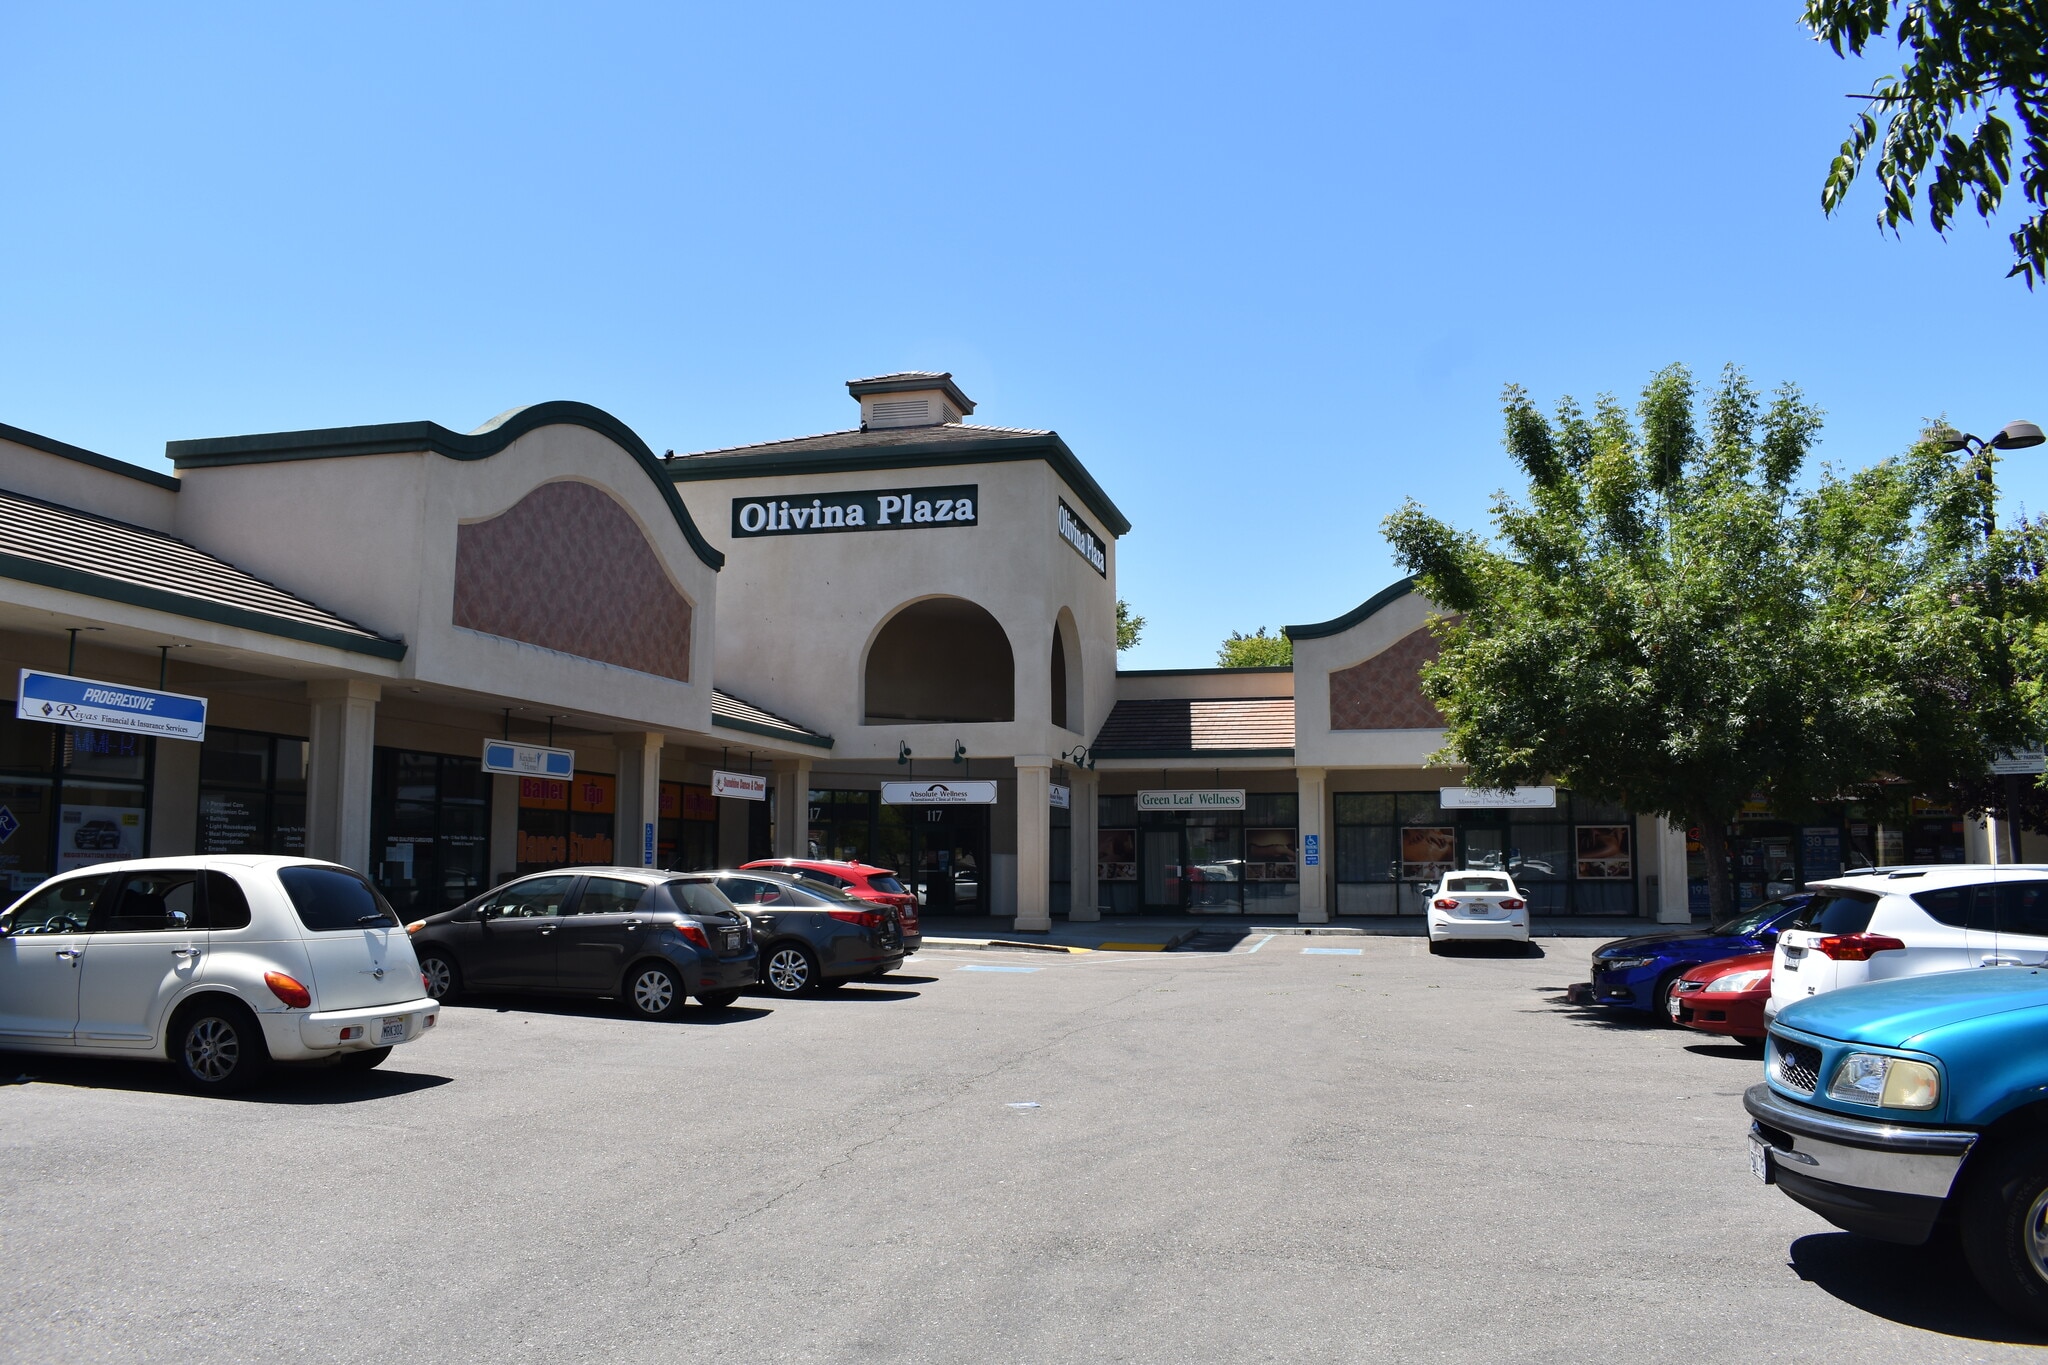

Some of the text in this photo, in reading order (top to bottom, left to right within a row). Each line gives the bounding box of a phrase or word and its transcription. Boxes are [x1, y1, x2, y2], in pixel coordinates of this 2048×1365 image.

[739, 494, 975, 532] Olivina Plaza
[1058, 505, 1105, 573] Olivina Plaza
[82, 688, 156, 711] PROGRESSIVE
[56, 704, 98, 722] Rivas
[101, 715, 129, 726] Financial
[137, 719, 165, 729] Insurance
[166, 723, 188, 733] Services
[523, 778, 564, 800] Ballet
[582, 784, 604, 804] Tap
[1142, 794, 1240, 805] Green Leaf Wellness
[1482, 797, 1504, 805] Therapy
[808, 807, 821, 820] 17
[927, 810, 943, 822] 117
[518, 830, 567, 863] Dance
[1740, 855, 1754, 866] 10
[1740, 888, 1753, 898] 35
